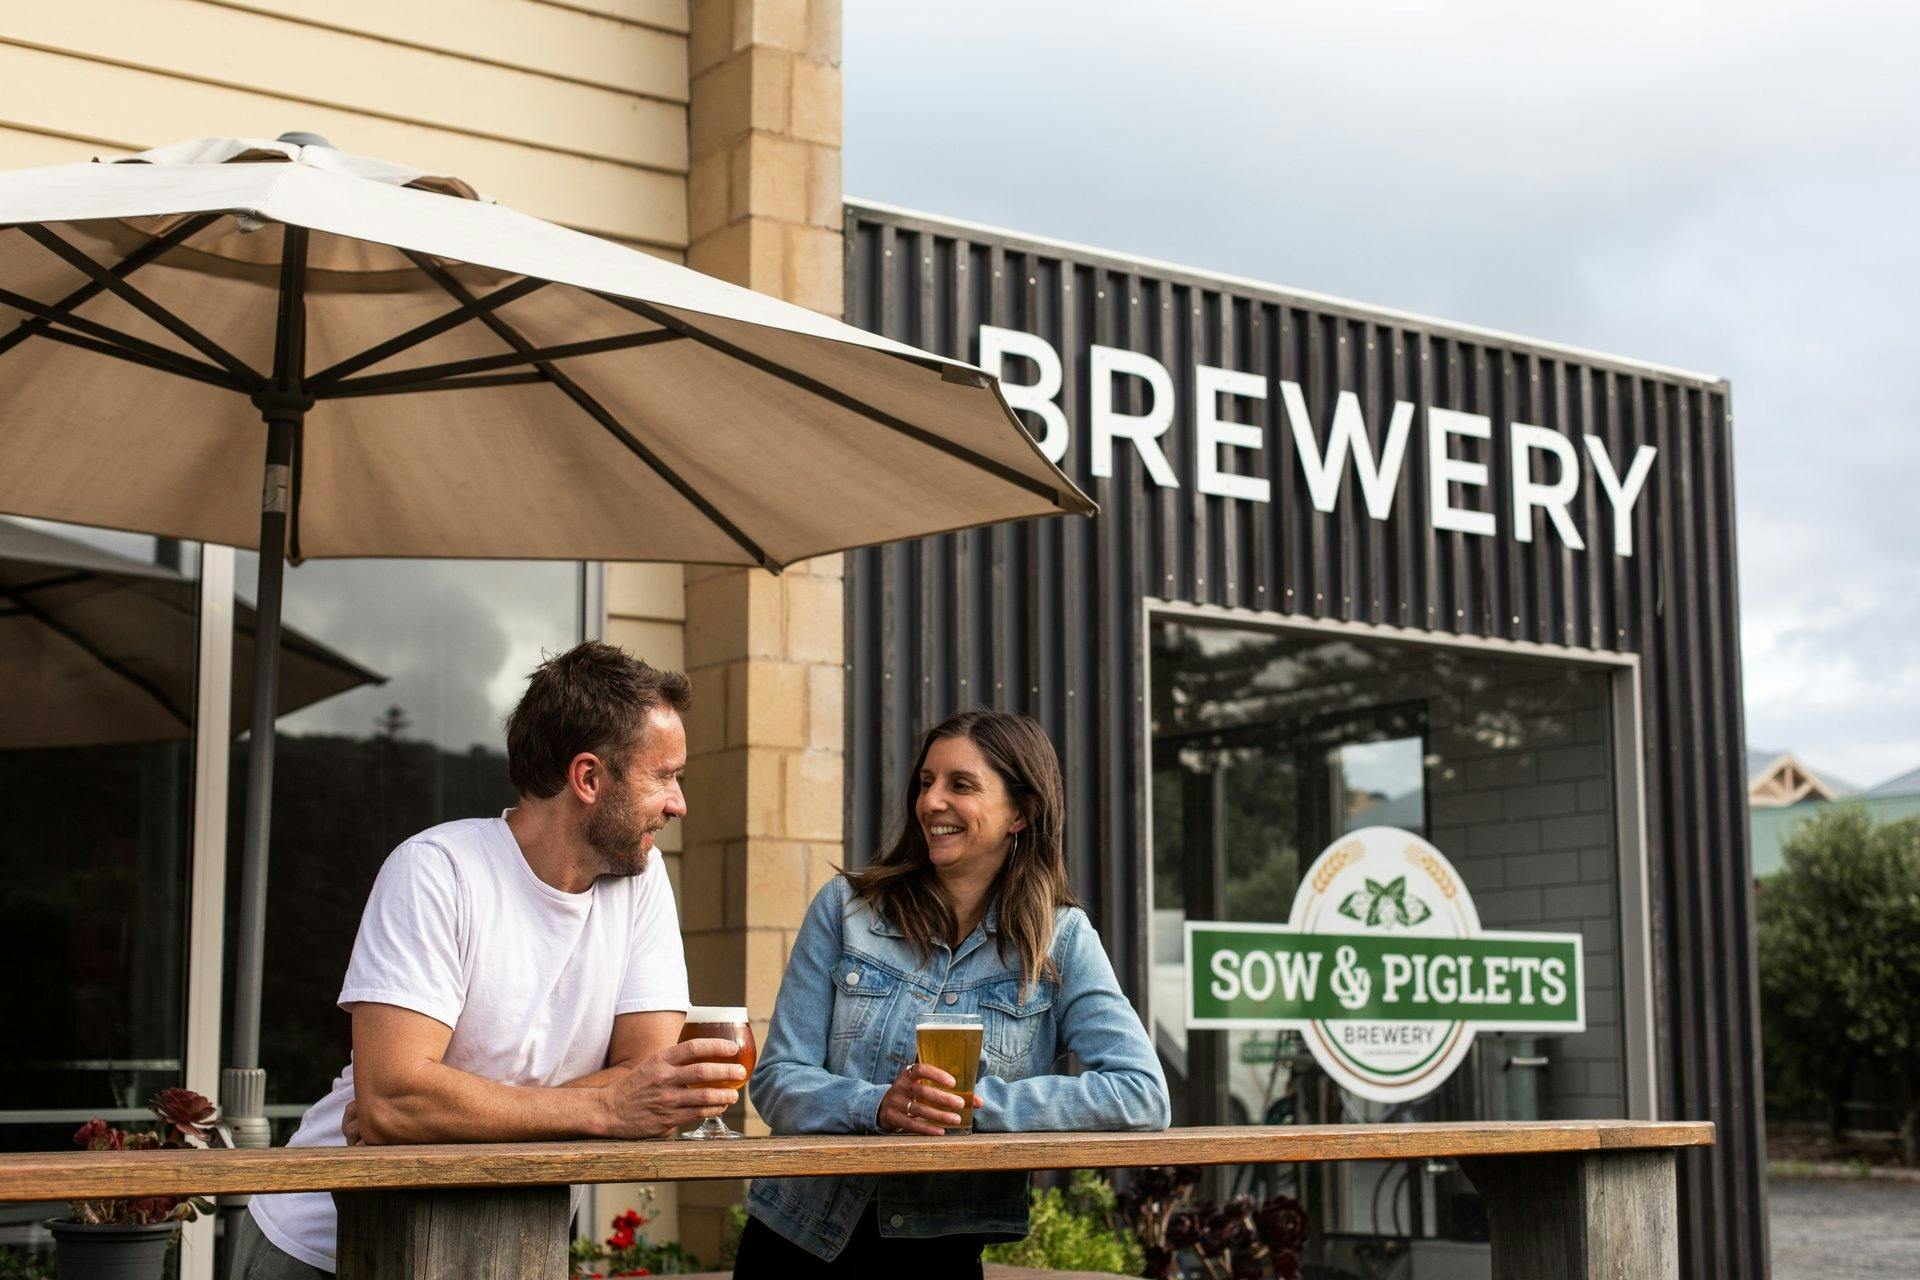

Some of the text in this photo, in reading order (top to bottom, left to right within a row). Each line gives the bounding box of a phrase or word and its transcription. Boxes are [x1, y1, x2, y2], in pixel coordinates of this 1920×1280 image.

[979, 324, 1657, 557] BREWERY
[1210, 945, 1567, 1010] SOW & PIGLETS
[1344, 1026, 1434, 1045] BREWERY
